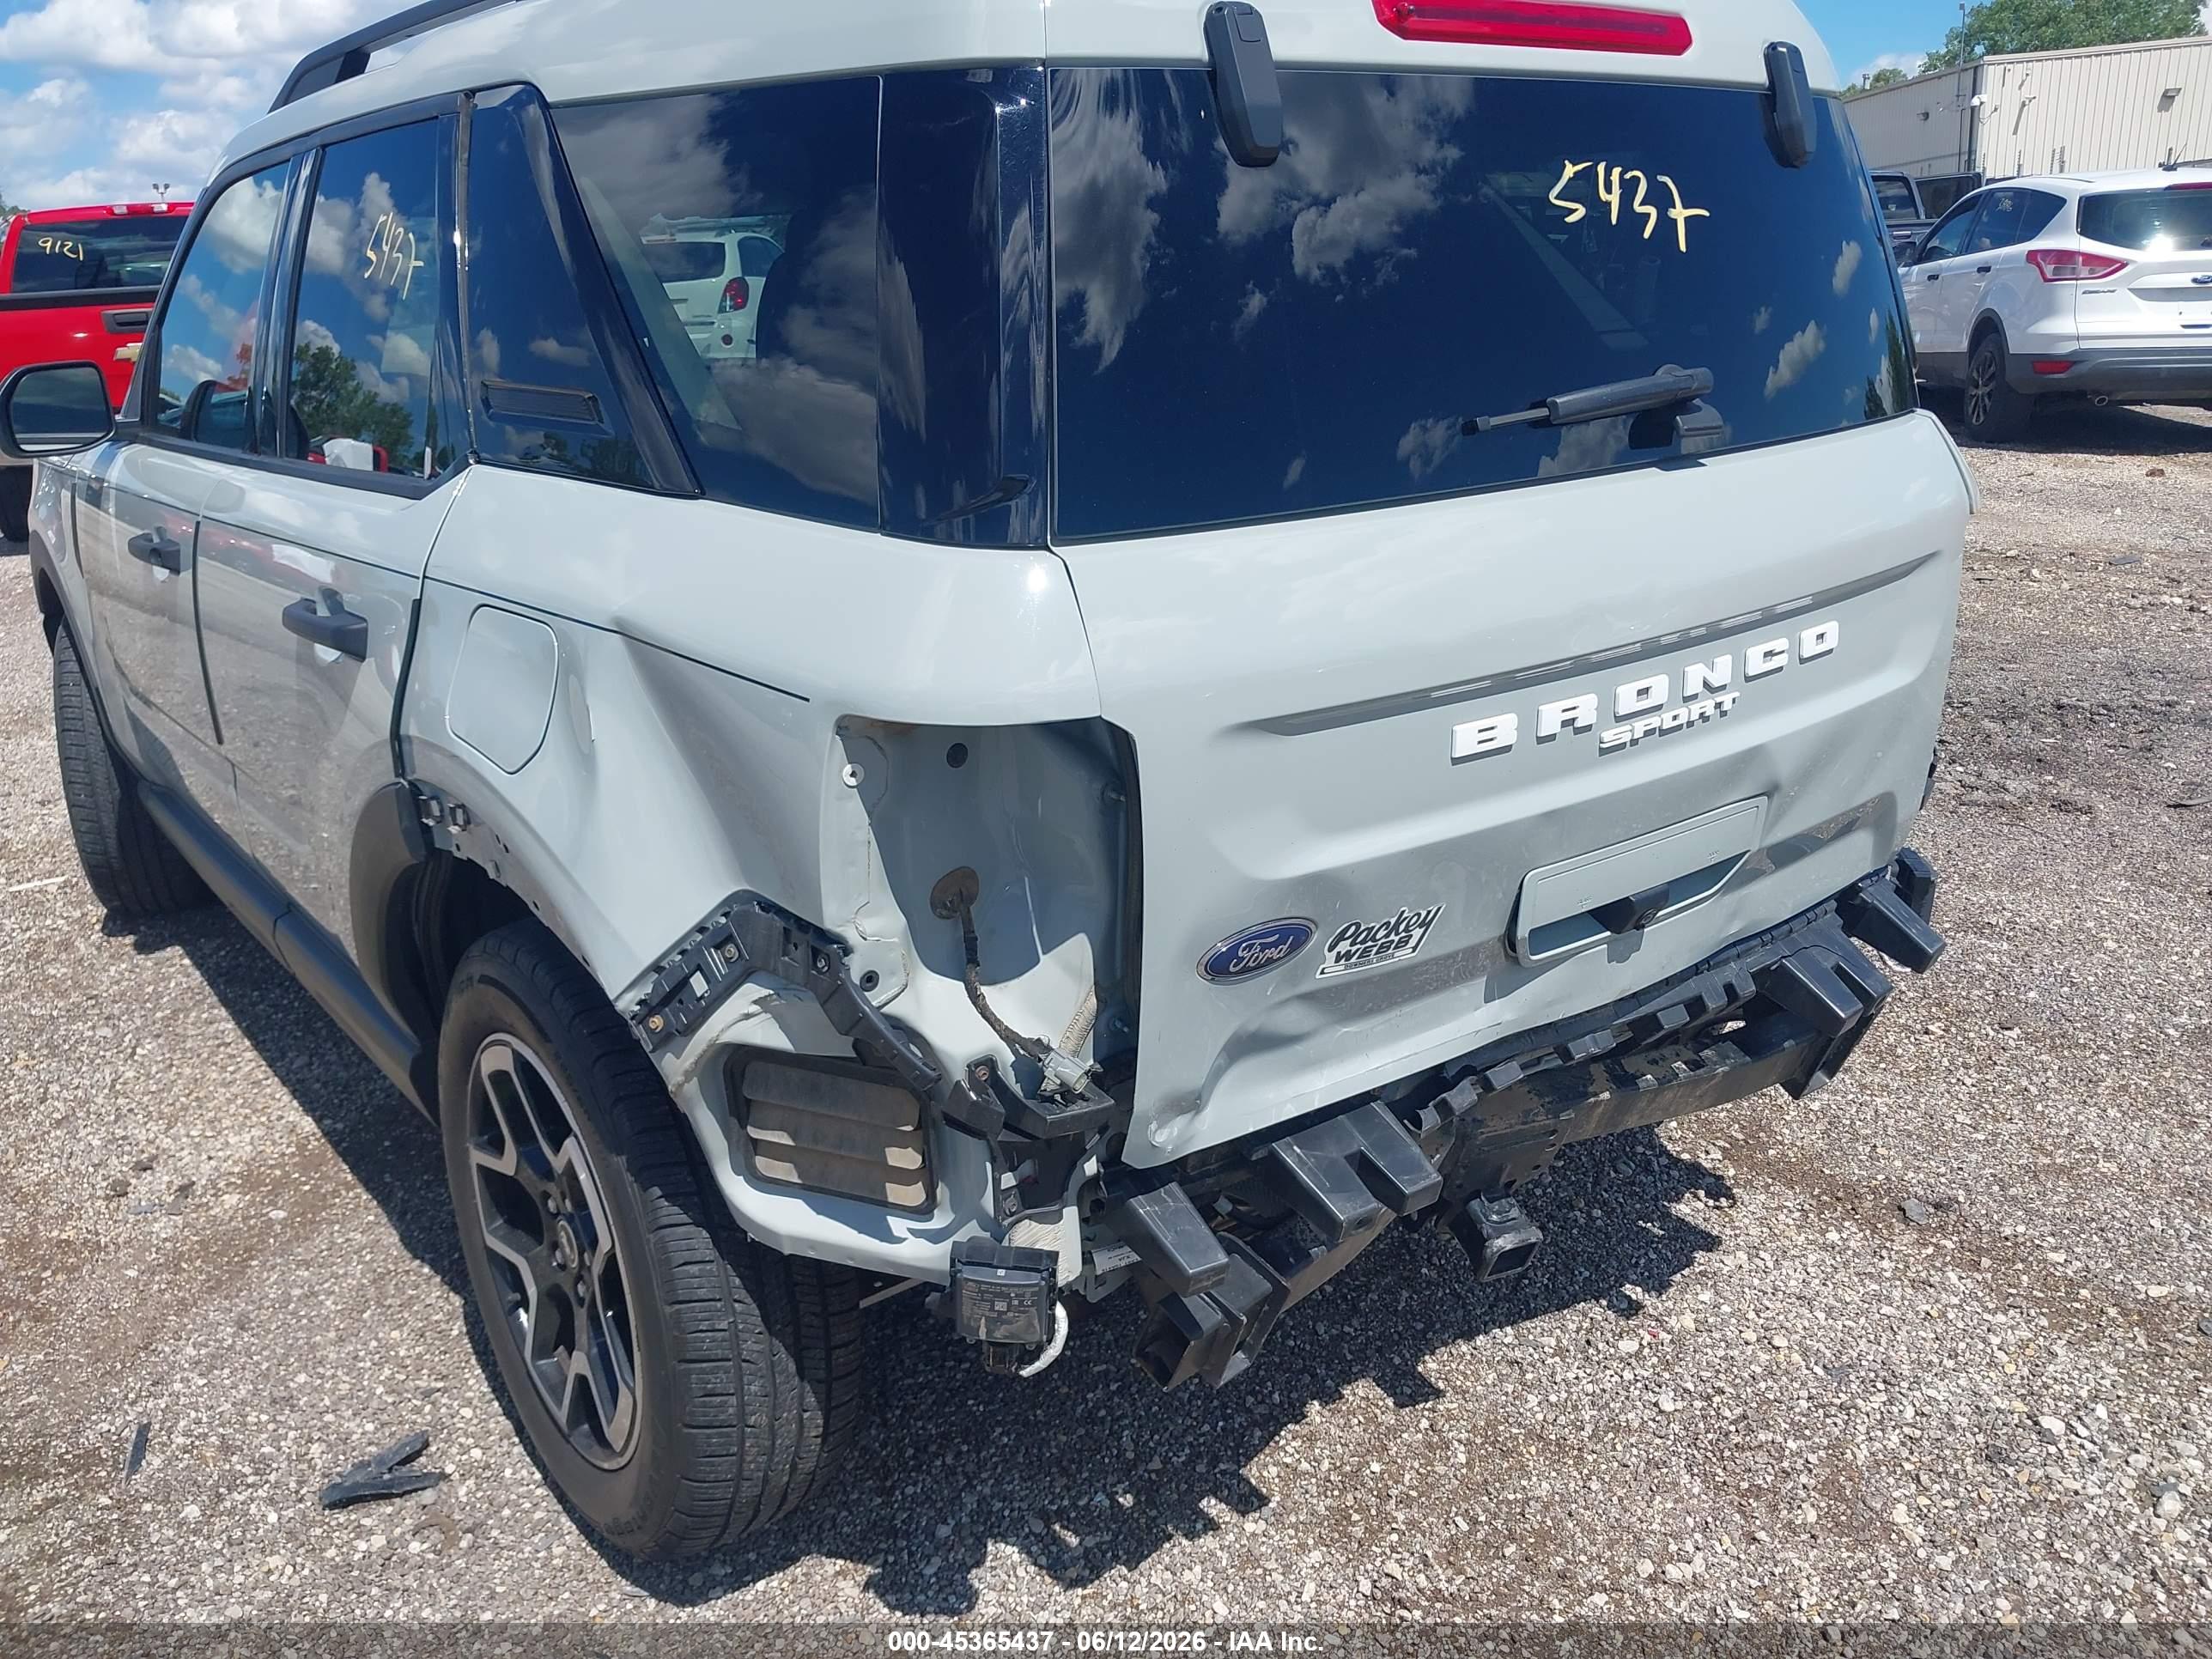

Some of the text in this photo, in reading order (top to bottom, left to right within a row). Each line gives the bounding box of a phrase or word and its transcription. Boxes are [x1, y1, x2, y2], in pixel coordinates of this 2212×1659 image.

[1548, 160, 1710, 252] 5437
[38, 236, 83, 261] 9121
[364, 212, 424, 300] 5437
[1450, 620, 1839, 763] BRONCO
[1598, 691, 1741, 752] SPORT
[1229, 933, 1294, 972] Ford
[1327, 904, 1444, 952] Packey
[1334, 934, 1413, 963] WEBB
